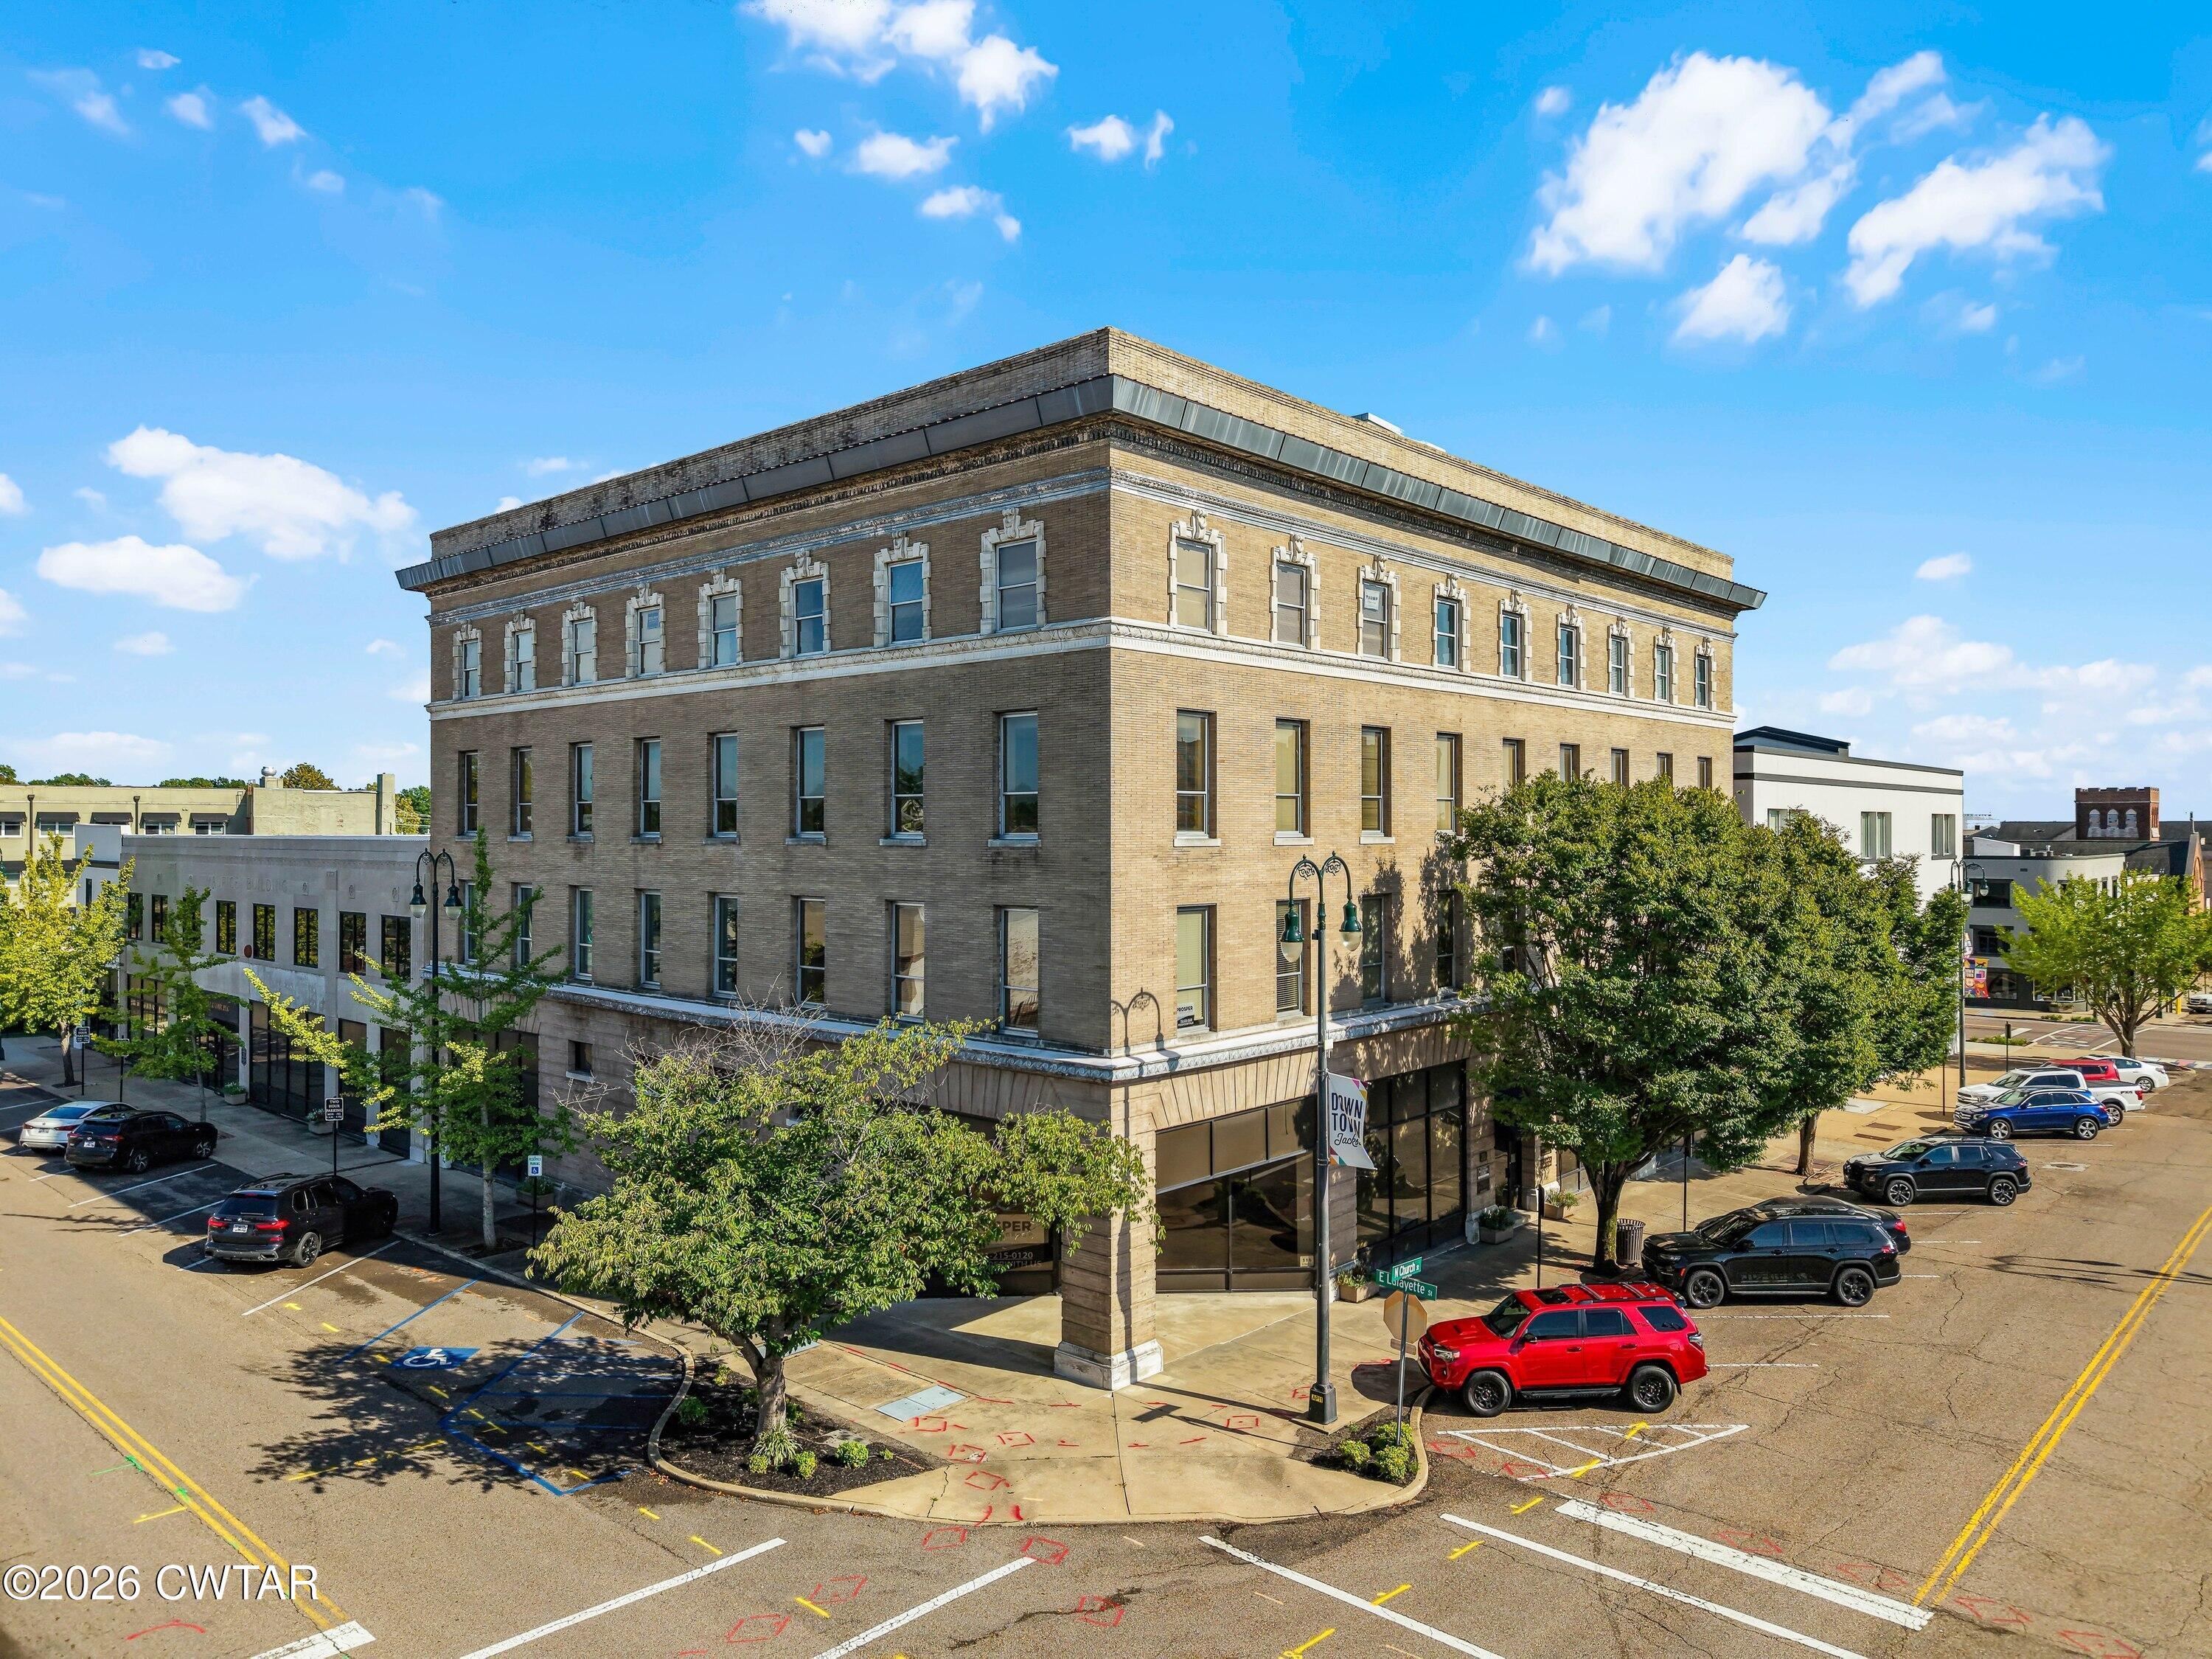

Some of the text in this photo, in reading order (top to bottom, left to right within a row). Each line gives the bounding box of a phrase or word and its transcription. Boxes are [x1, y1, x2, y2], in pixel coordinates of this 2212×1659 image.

[1379, 1271, 1385, 1283] E
[1394, 1267, 1399, 1279] N
[1399, 1262, 1415, 1276] Church
